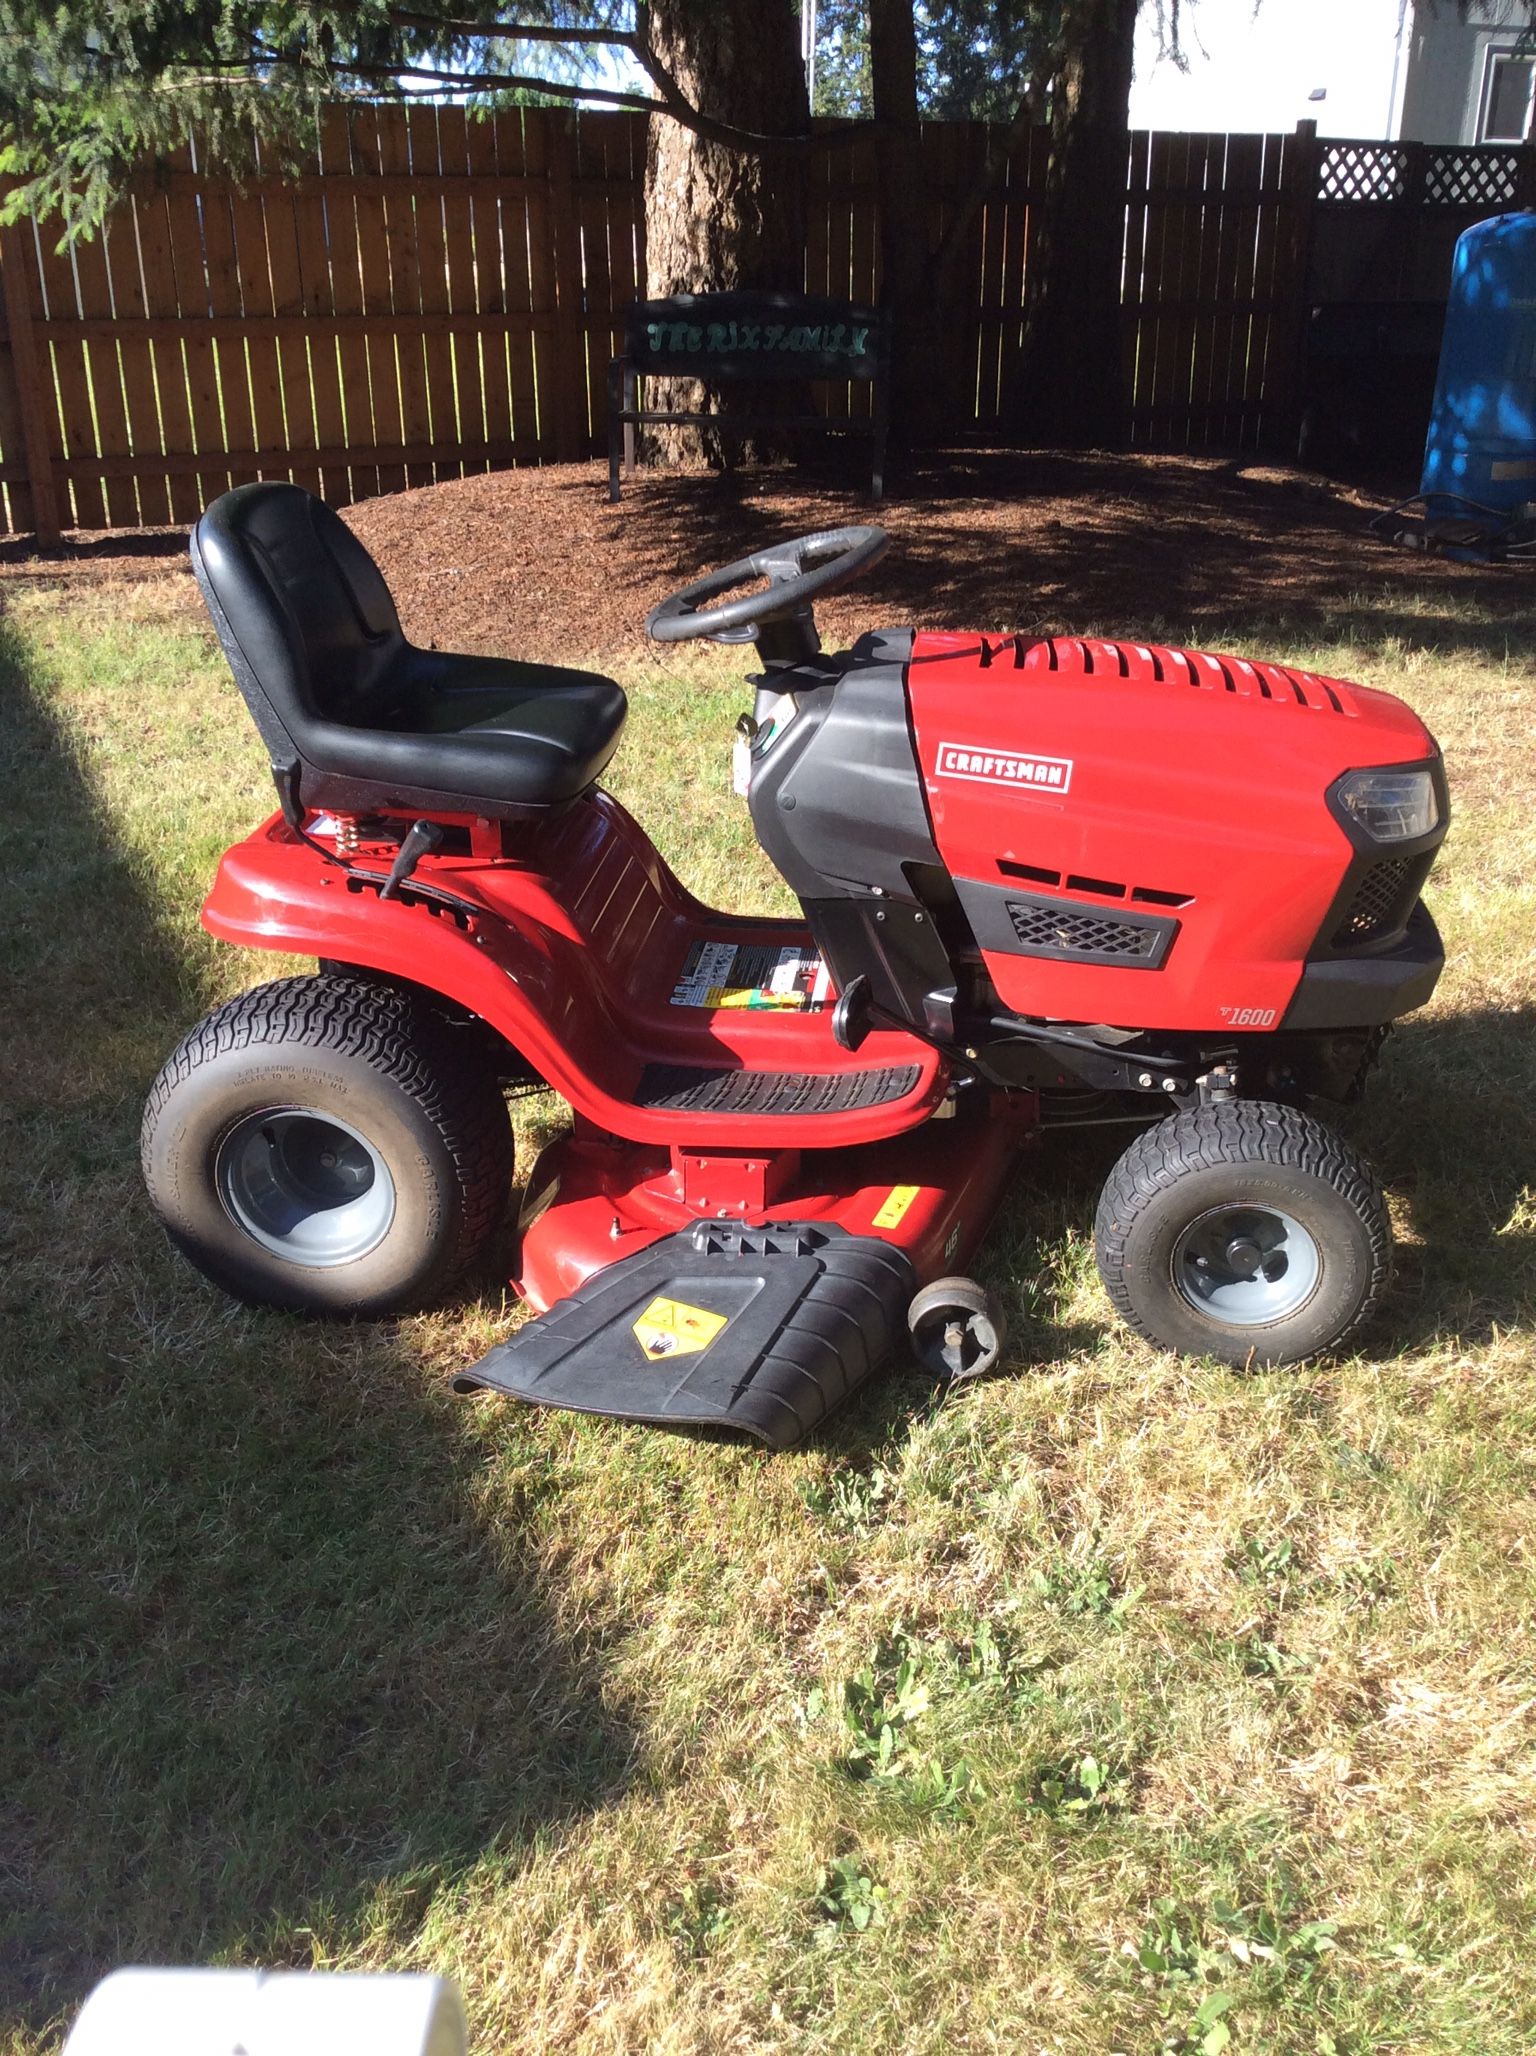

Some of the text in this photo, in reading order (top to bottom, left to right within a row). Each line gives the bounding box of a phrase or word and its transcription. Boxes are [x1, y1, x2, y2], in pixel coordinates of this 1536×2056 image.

[945, 751, 1063, 784] CRAFTSMAN
[1220, 1006, 1276, 1026] T1600
[415, 1152, 441, 1240] CARLISLE
